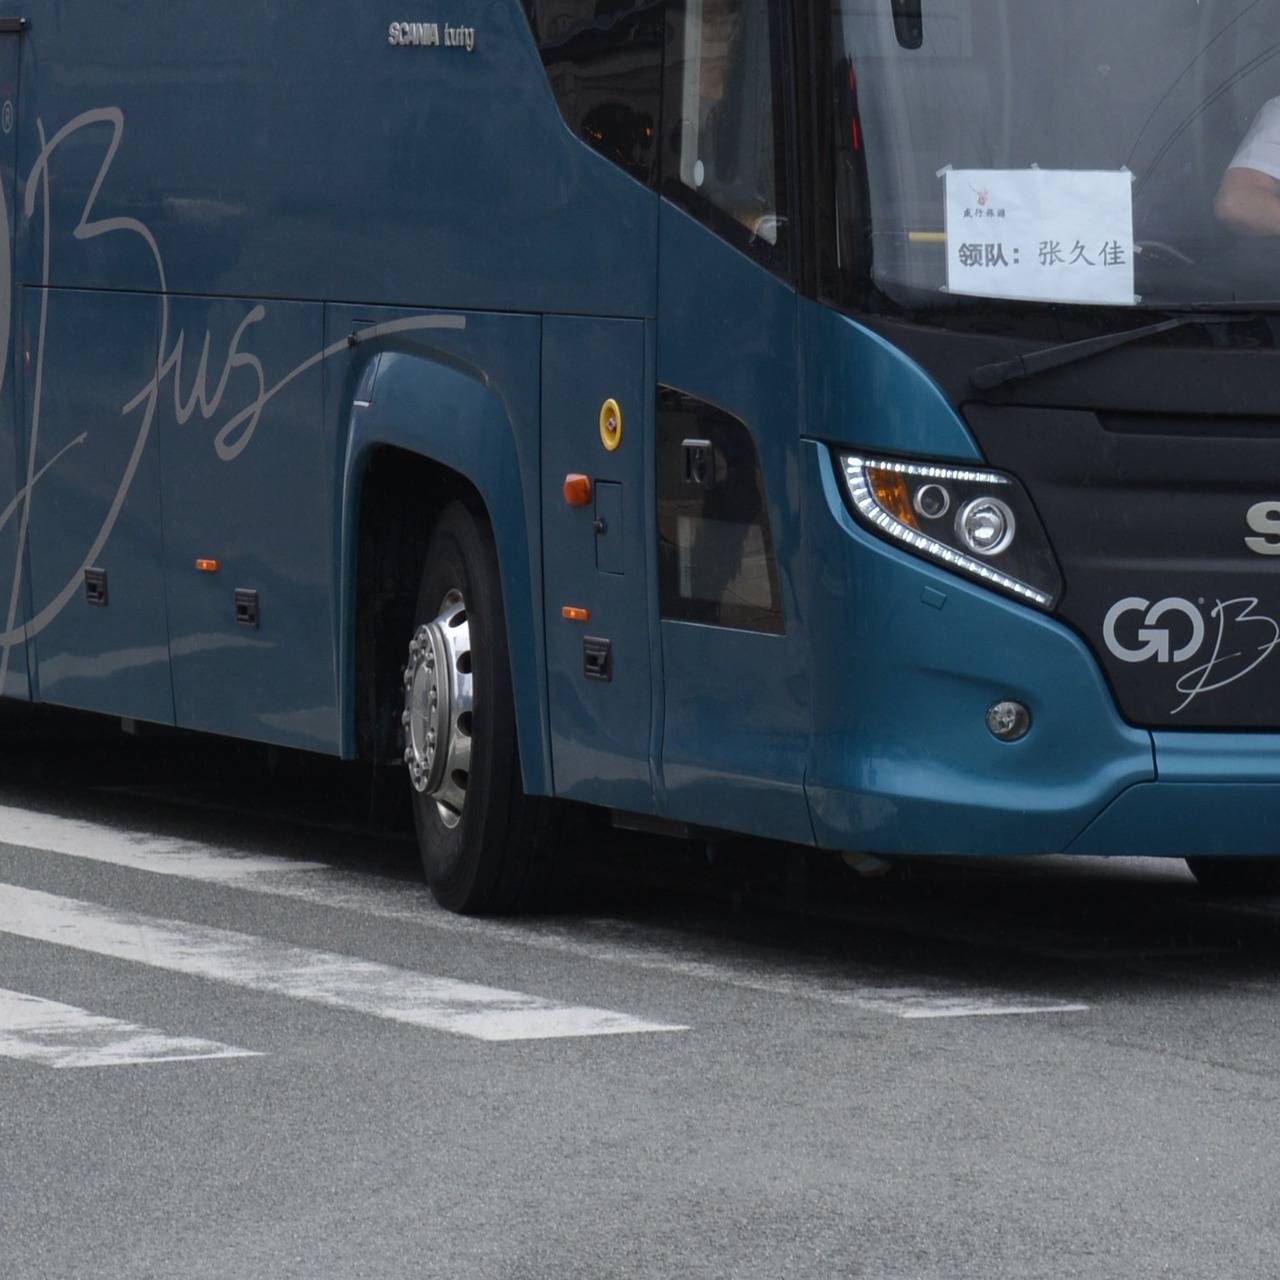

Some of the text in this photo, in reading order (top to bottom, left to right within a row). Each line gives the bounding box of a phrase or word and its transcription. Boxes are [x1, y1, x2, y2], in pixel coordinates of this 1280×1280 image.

[387, 21, 475, 52] SCANIA touring
[1102, 596, 1205, 664] GO
